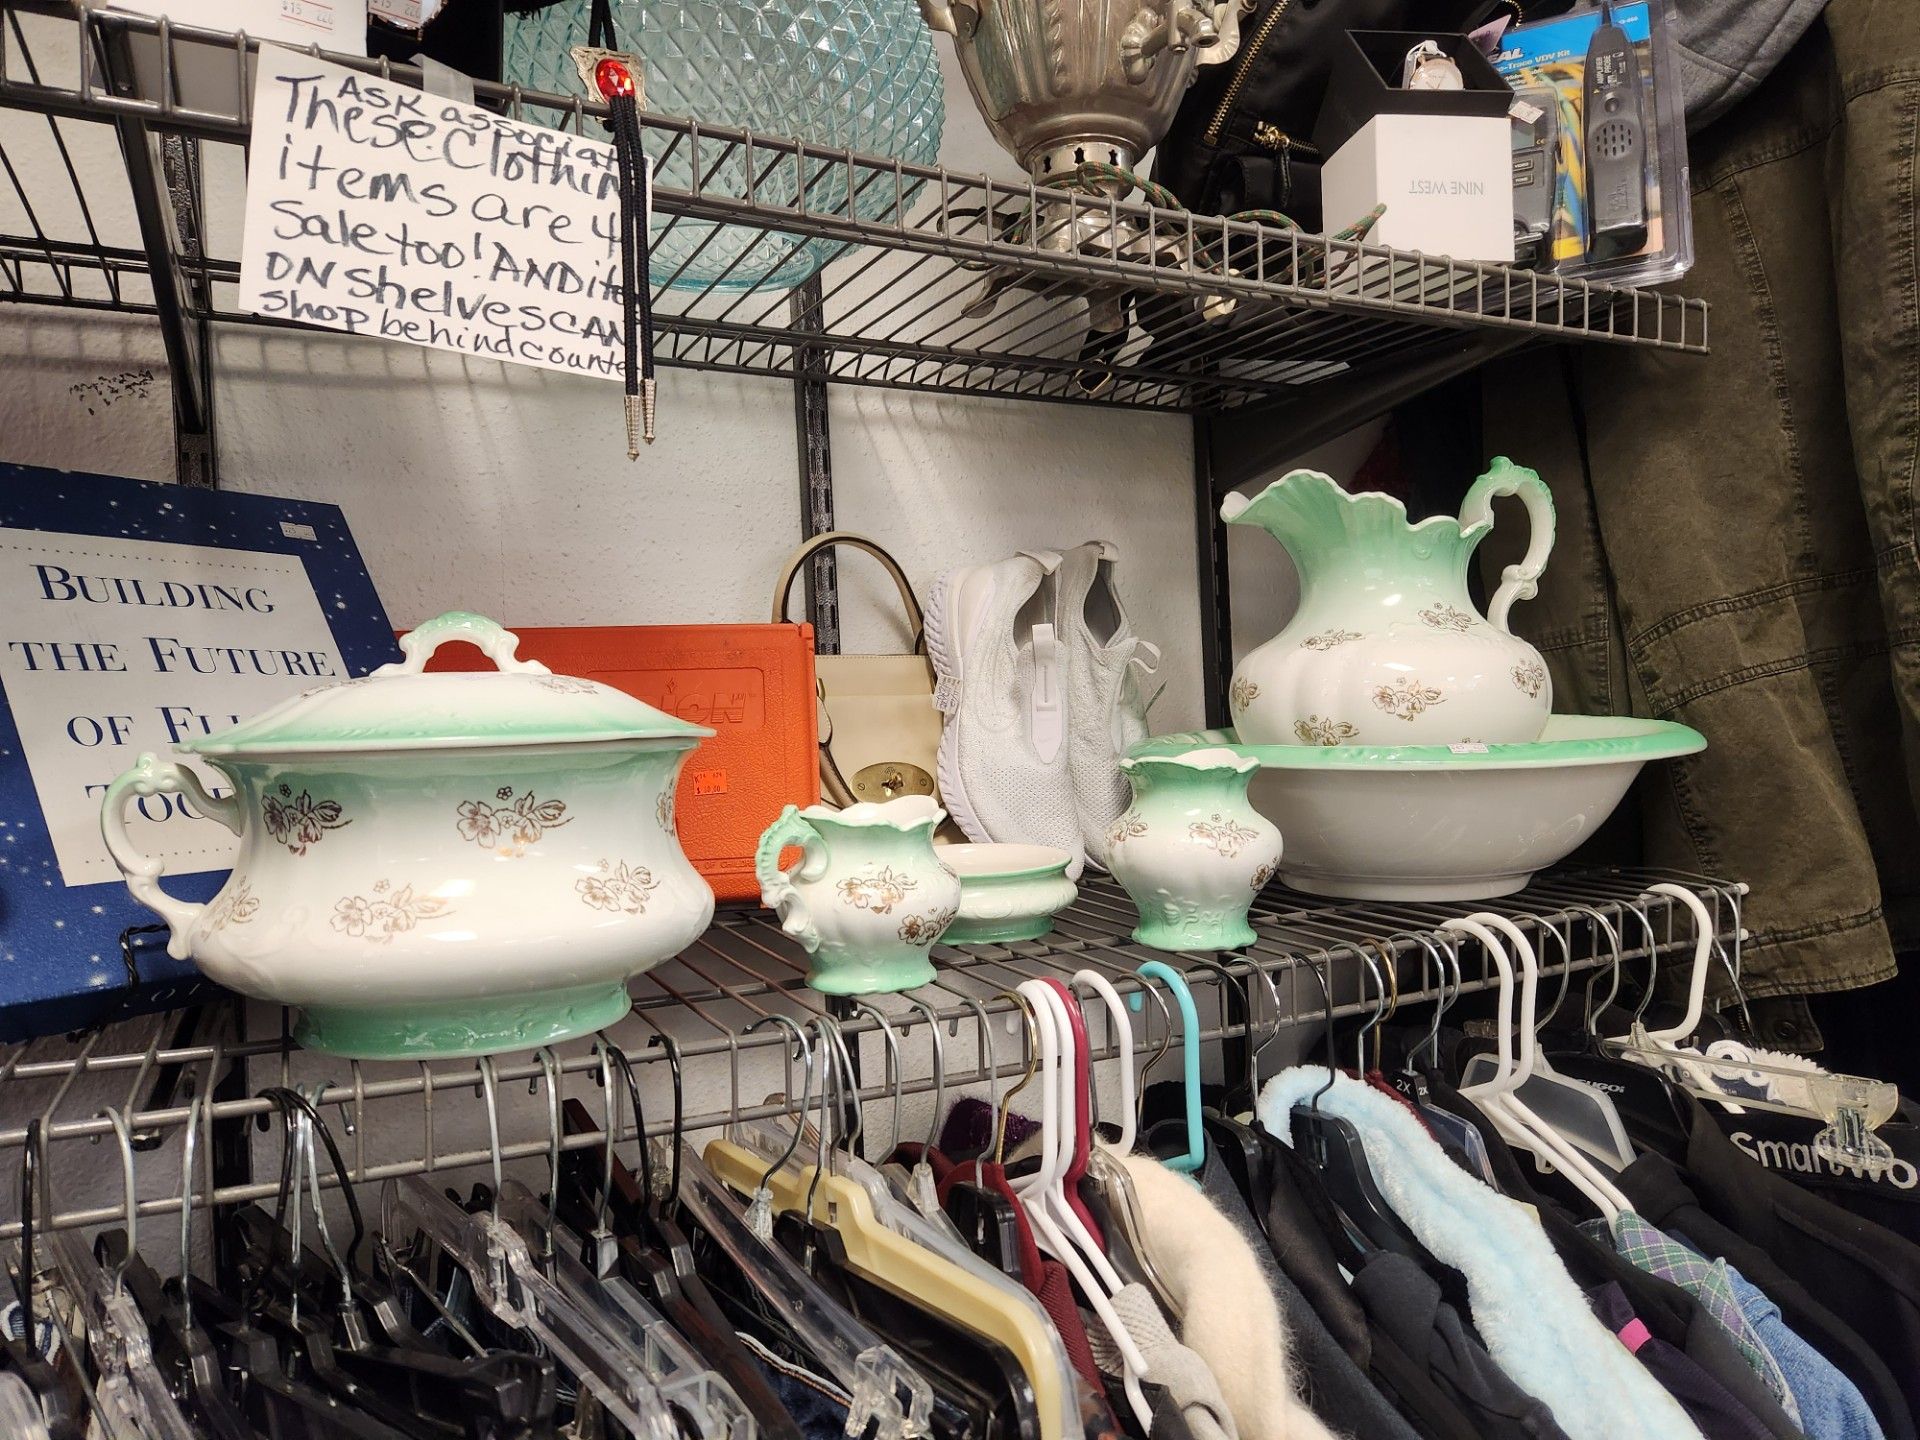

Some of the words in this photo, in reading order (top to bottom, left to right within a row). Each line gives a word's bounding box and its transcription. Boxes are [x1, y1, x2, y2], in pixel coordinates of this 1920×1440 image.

[275, 74, 440, 162] These
[442, 126, 621, 200] Clothin
[439, 106, 619, 173] associat
[279, 133, 458, 217] items
[471, 193, 584, 244] are
[591, 211, 622, 261] 4
[1408, 180, 1448, 195] WEST
[1450, 181, 1484, 195] NINE
[489, 241, 584, 294] AND
[380, 308, 514, 358] behind
[519, 341, 632, 377] counte
[30, 564, 275, 614] BUILDING
[9, 641, 127, 672] THE
[142, 637, 336, 677] FUTURE
[66, 716, 134, 747] OF
[1396, 1079, 1412, 1095] 2X
[1418, 1085, 1429, 1096] 2X
